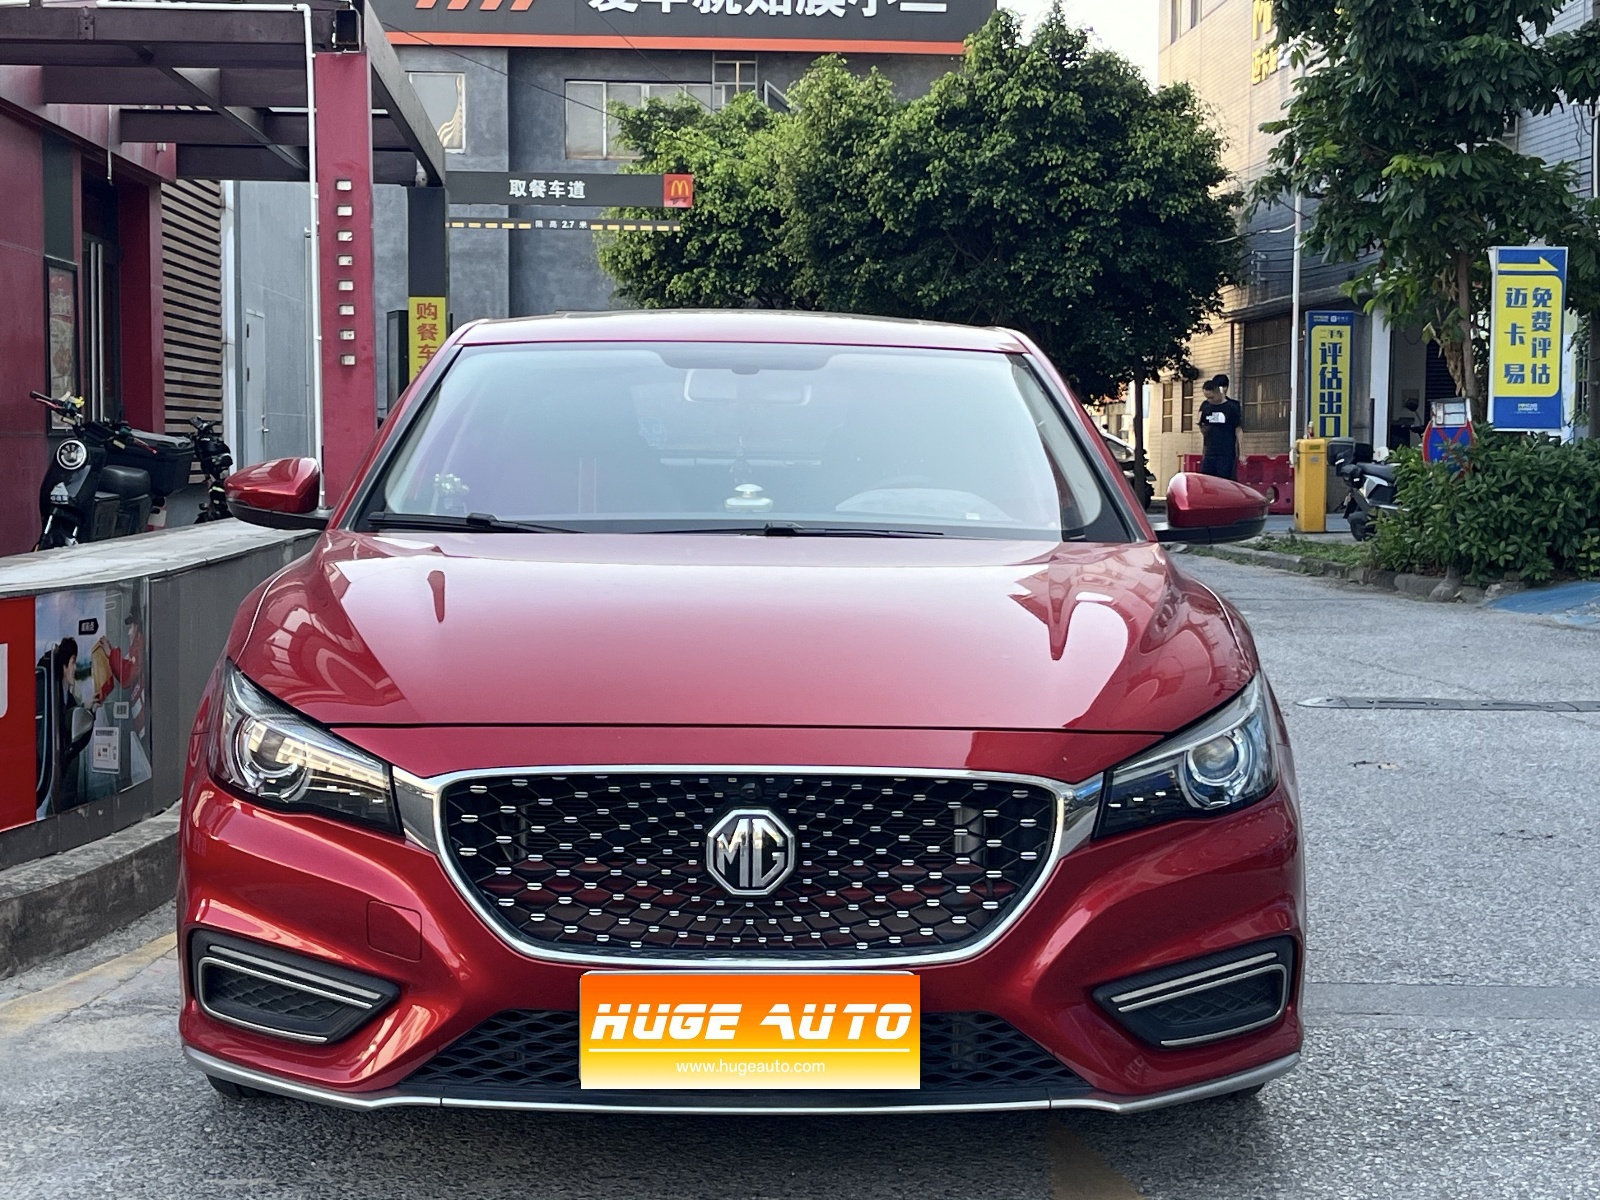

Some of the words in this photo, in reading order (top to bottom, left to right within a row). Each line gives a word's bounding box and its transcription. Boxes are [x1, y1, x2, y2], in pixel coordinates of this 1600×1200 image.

[508, 178, 587, 200] 取餐车道
[416, 302, 438, 374] 购餐车
[1503, 287, 1528, 385] 迈卡易
[1531, 287, 1553, 384] 免费评估
[1319, 342, 1342, 438] 评估出口
[714, 817, 787, 889] MG
